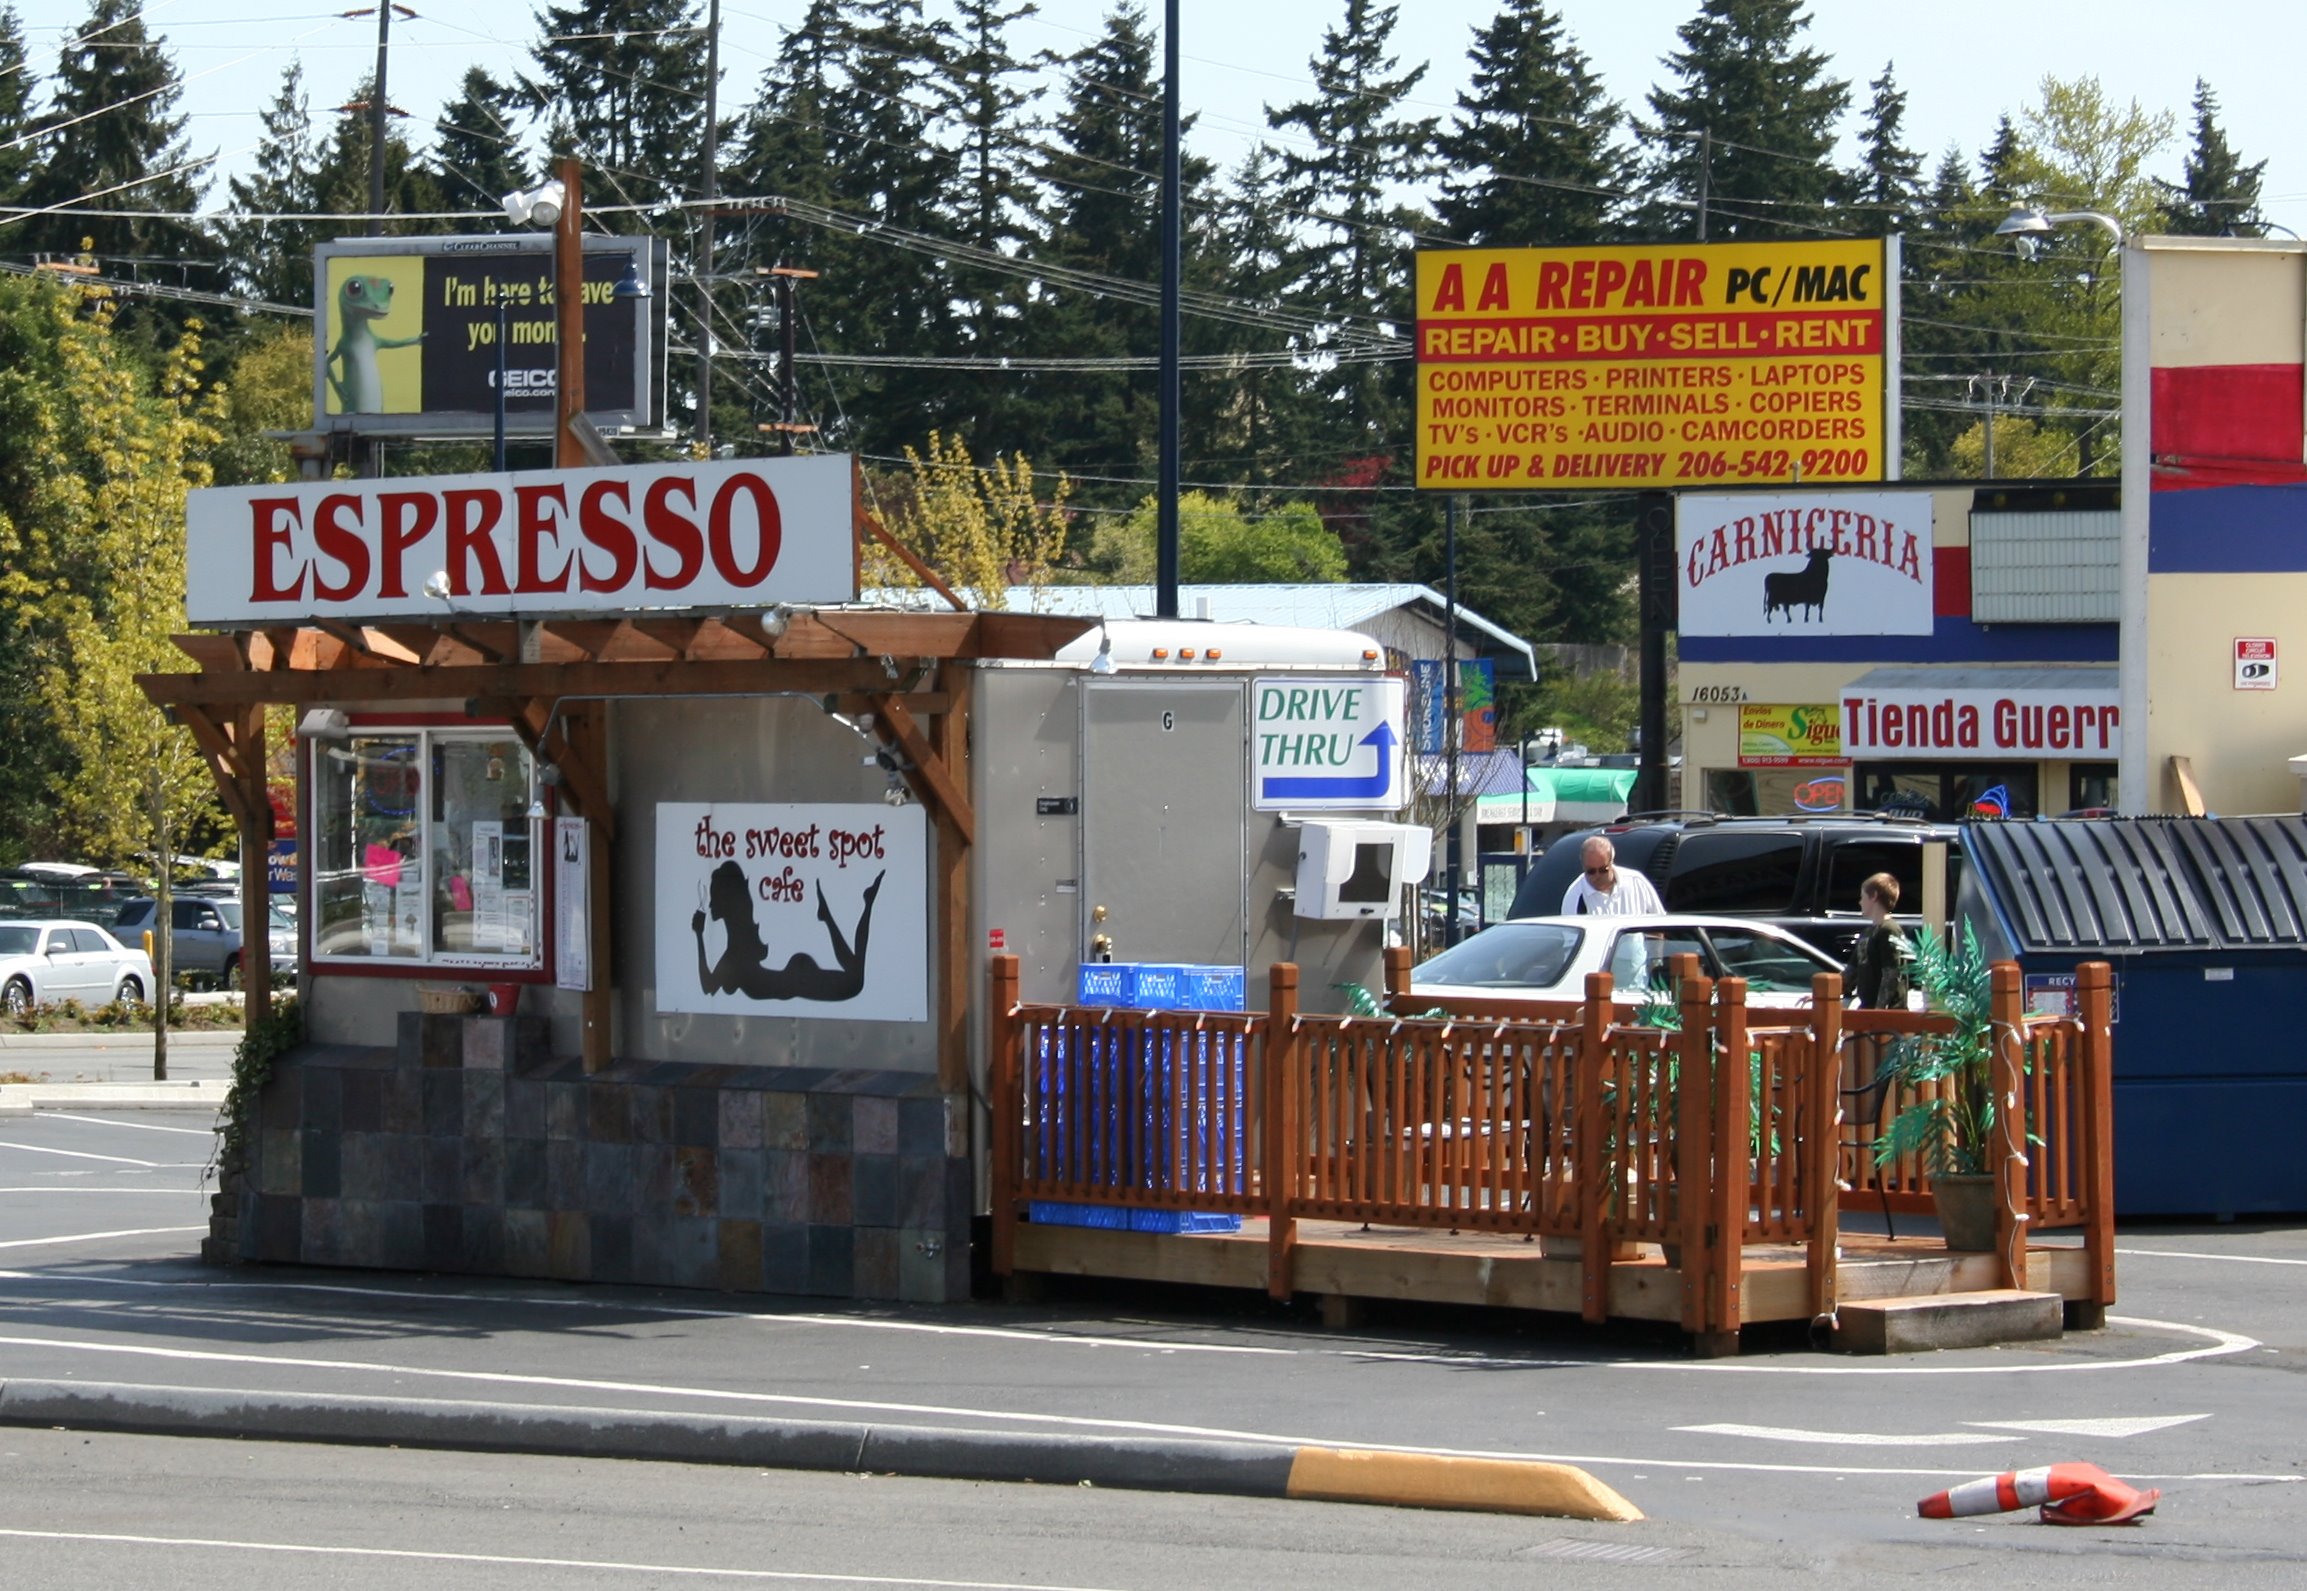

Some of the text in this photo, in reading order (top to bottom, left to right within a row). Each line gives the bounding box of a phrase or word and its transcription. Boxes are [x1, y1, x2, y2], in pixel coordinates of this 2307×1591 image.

[444, 277, 476, 306] I'm
[581, 281, 614, 304] ave
[1432, 258, 1871, 311] A A REPAIR PC/MAC
[1425, 318, 1872, 355] REPAIR BUY SELL RENT
[1428, 364, 1865, 392] COMPUTERS PRINTERS LAPTOPS
[1432, 391, 1862, 418] MONITORS TERMINALS COPIERS
[1428, 418, 1866, 445] TV's VCR's AUDIO CAMCORDERS
[1425, 449, 1868, 479] PICK UP & DELIVERY 206-542-9200
[248, 472, 782, 603] ESPRESSO
[1687, 508, 1922, 588] CARNICERIA
[1258, 688, 1362, 721] DRIVE
[1692, 686, 1741, 702] 16053
[1163, 712, 1173, 730] G
[1755, 719, 1785, 729] Dinero
[1843, 698, 1979, 748] Tienda
[1260, 734, 1354, 766] THRU
[695, 815, 885, 868] the sweet spot
[759, 866, 804, 902] cafe
